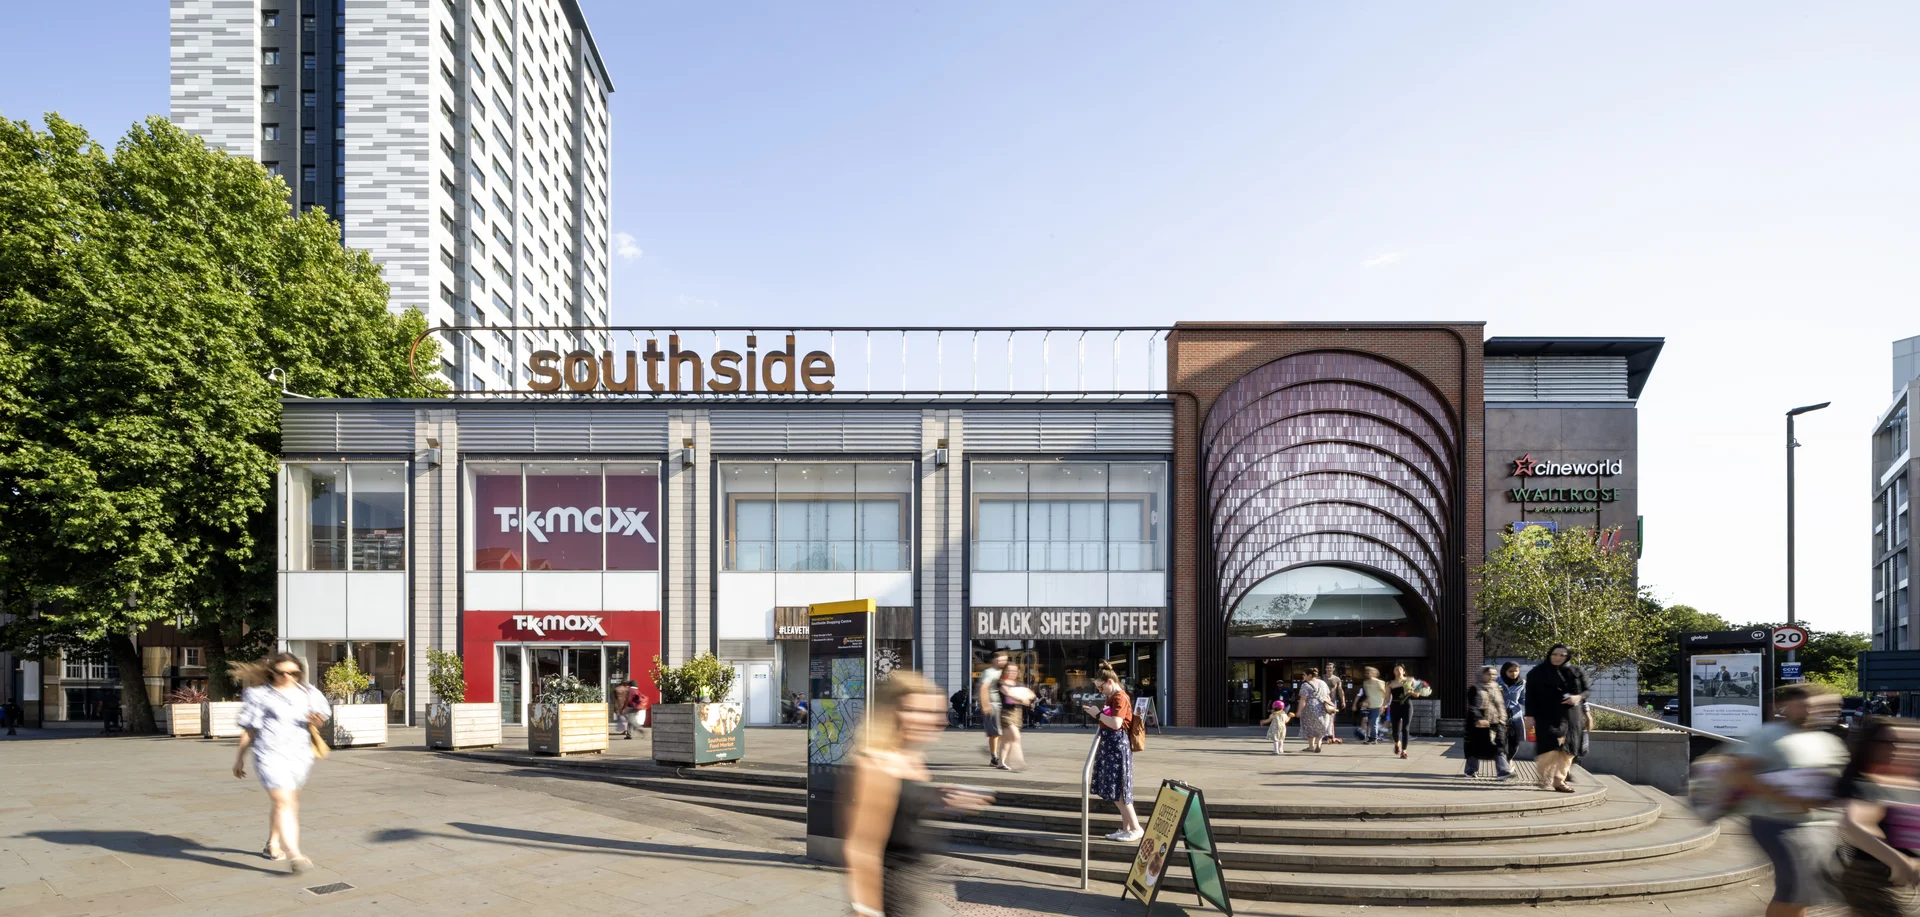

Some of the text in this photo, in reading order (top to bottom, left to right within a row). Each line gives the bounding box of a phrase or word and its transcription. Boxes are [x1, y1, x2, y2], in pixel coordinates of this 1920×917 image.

[528, 335, 836, 393] southside
[1535, 459, 1622, 475] cineworld
[1512, 487, 1621, 501] WAITROSE
[1534, 505, 1598, 513] & PARTNERS
[978, 611, 1159, 635] BLACK SHEEP COFFEE
[1690, 634, 1709, 642] global
[1775, 632, 1801, 643] 20
[1159, 804, 1176, 821] COFFEE
